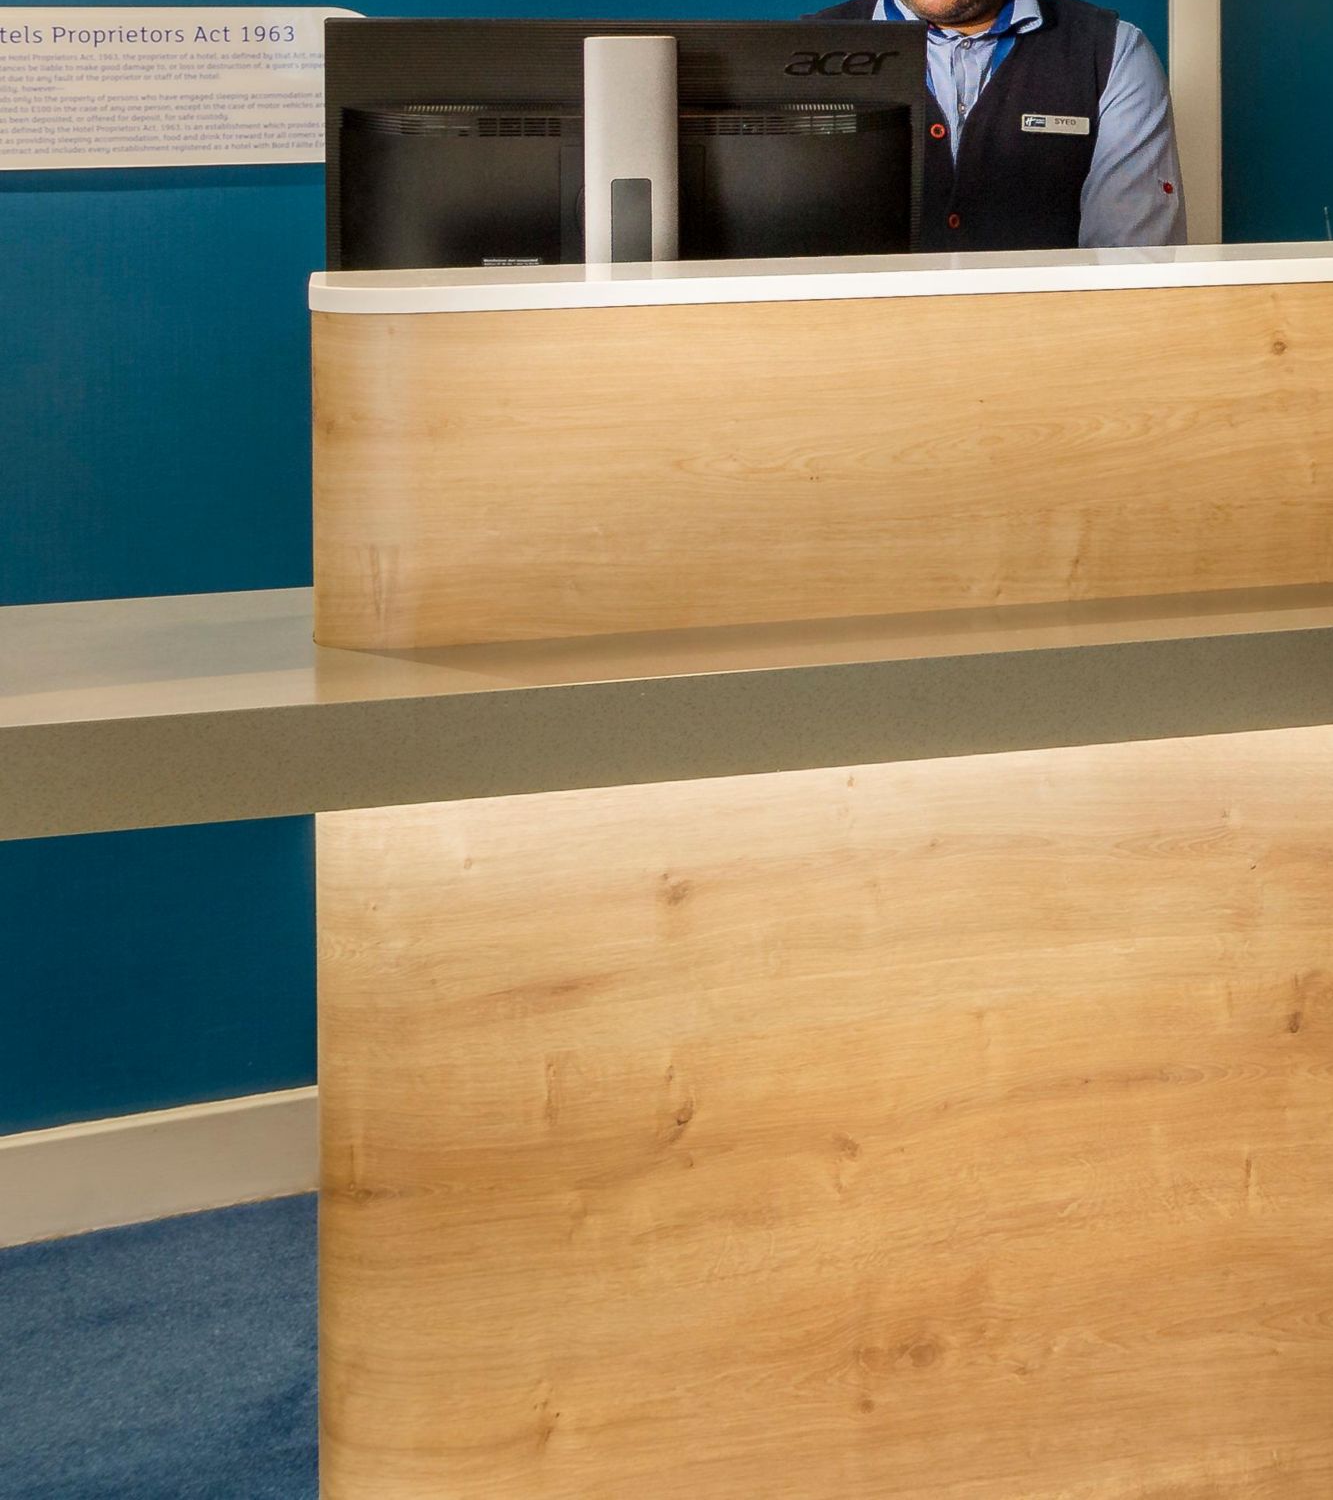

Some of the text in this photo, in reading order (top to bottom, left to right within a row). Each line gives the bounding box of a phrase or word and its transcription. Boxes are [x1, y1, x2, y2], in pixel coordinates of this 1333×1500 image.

[52, 25, 185, 48] Proprietors
[194, 25, 231, 43] Act
[241, 25, 295, 43] 1963
[784, 51, 900, 76] acer
